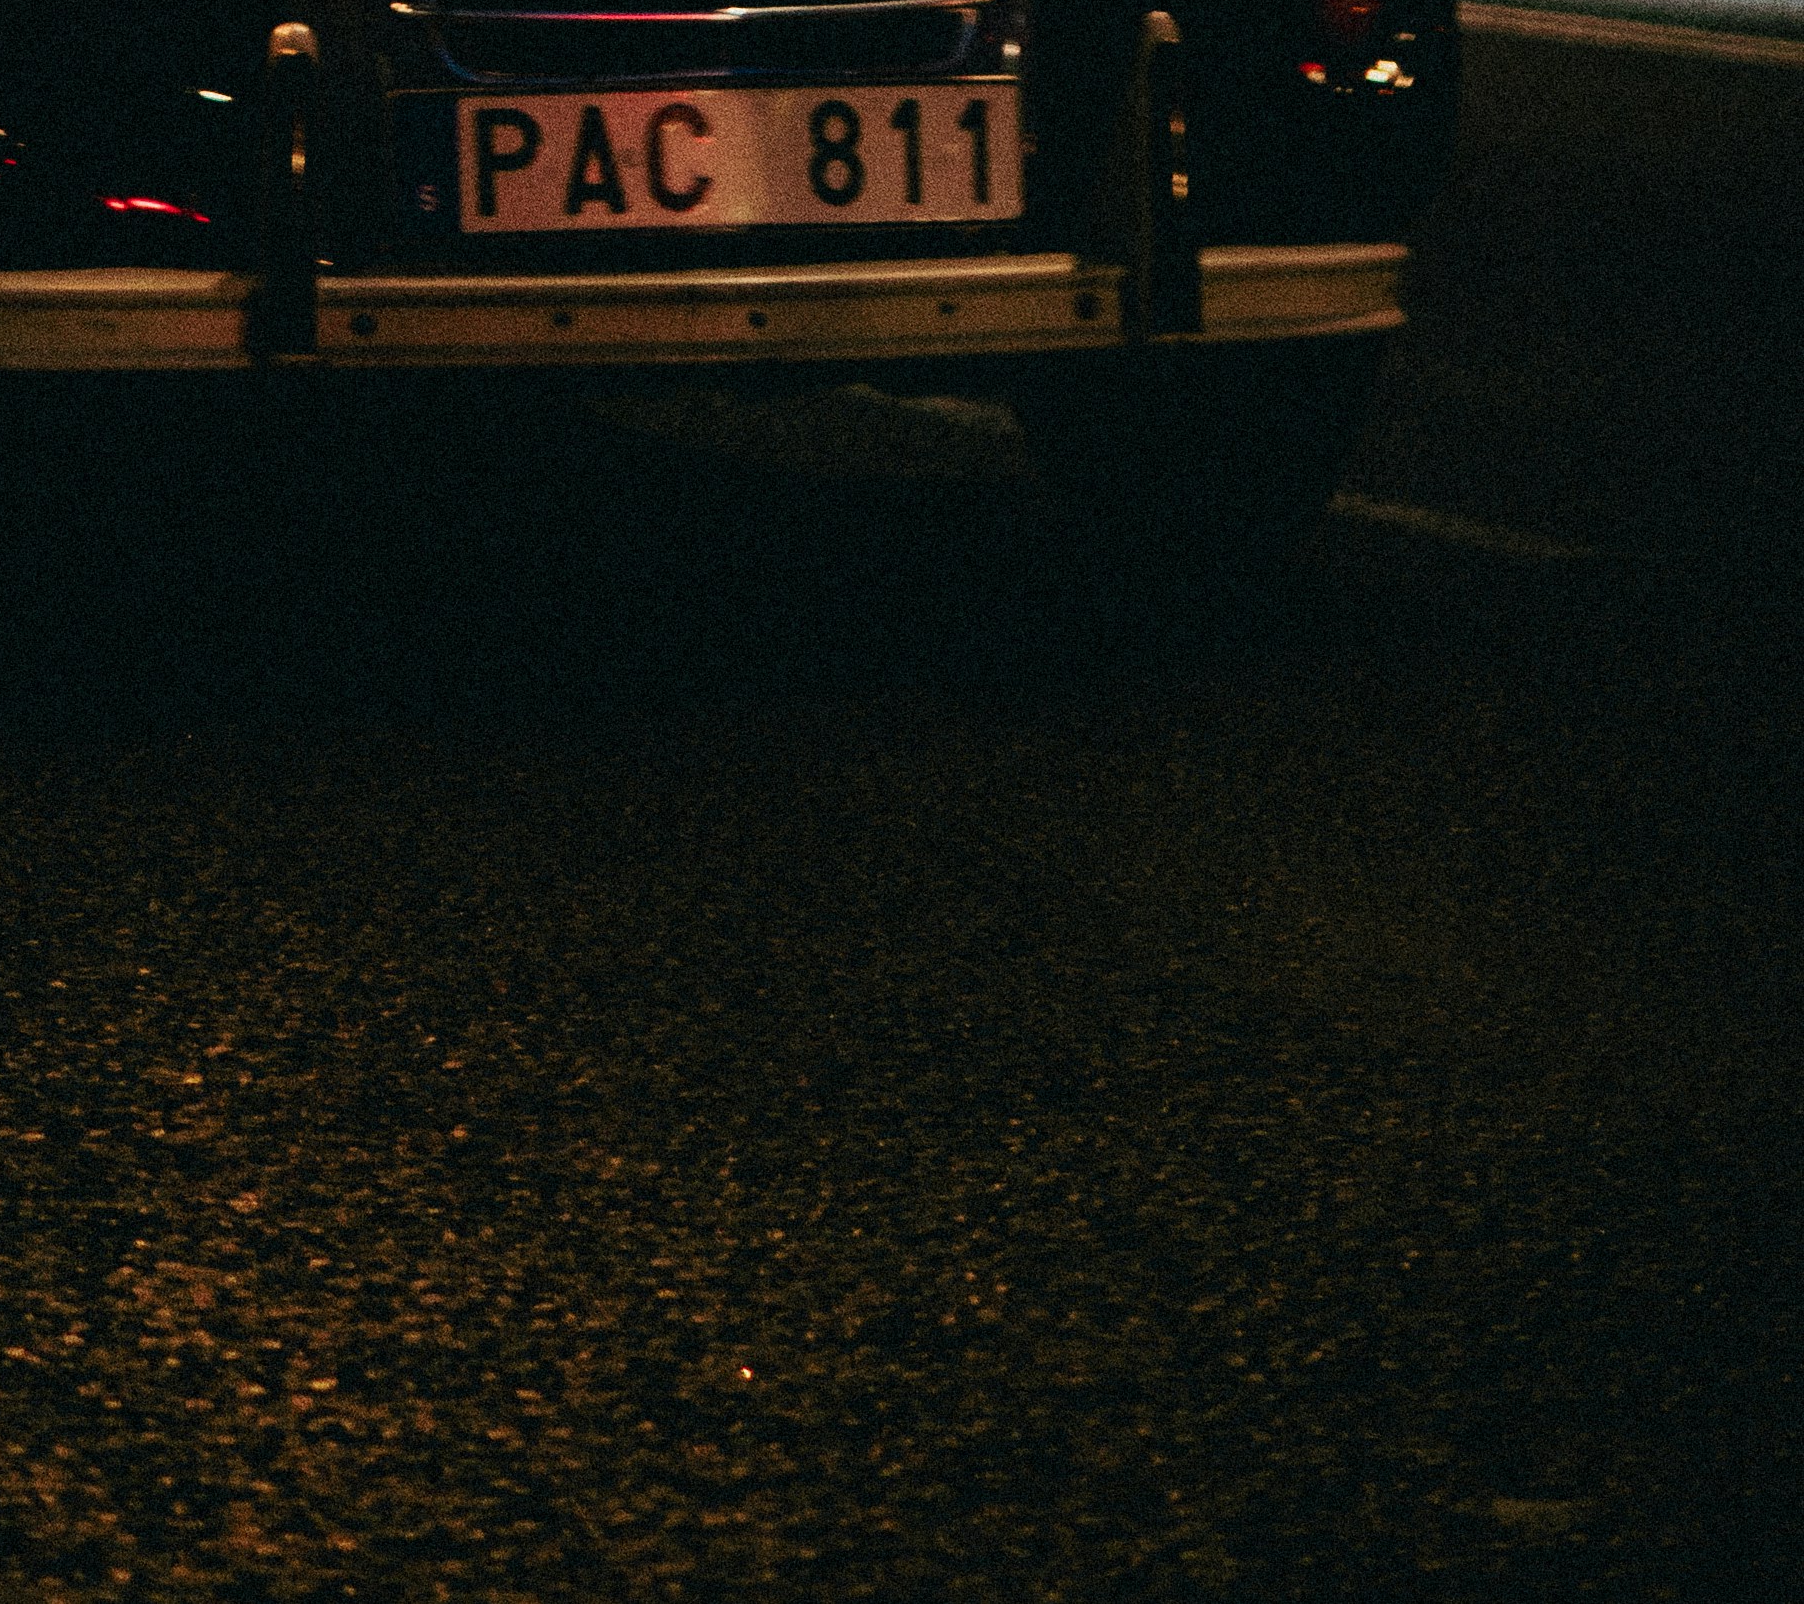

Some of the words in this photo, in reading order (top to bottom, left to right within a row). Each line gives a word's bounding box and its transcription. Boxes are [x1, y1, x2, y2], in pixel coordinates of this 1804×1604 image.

[473, 102, 714, 217] PAC
[807, 98, 990, 206] 811
[417, 184, 439, 212] S
